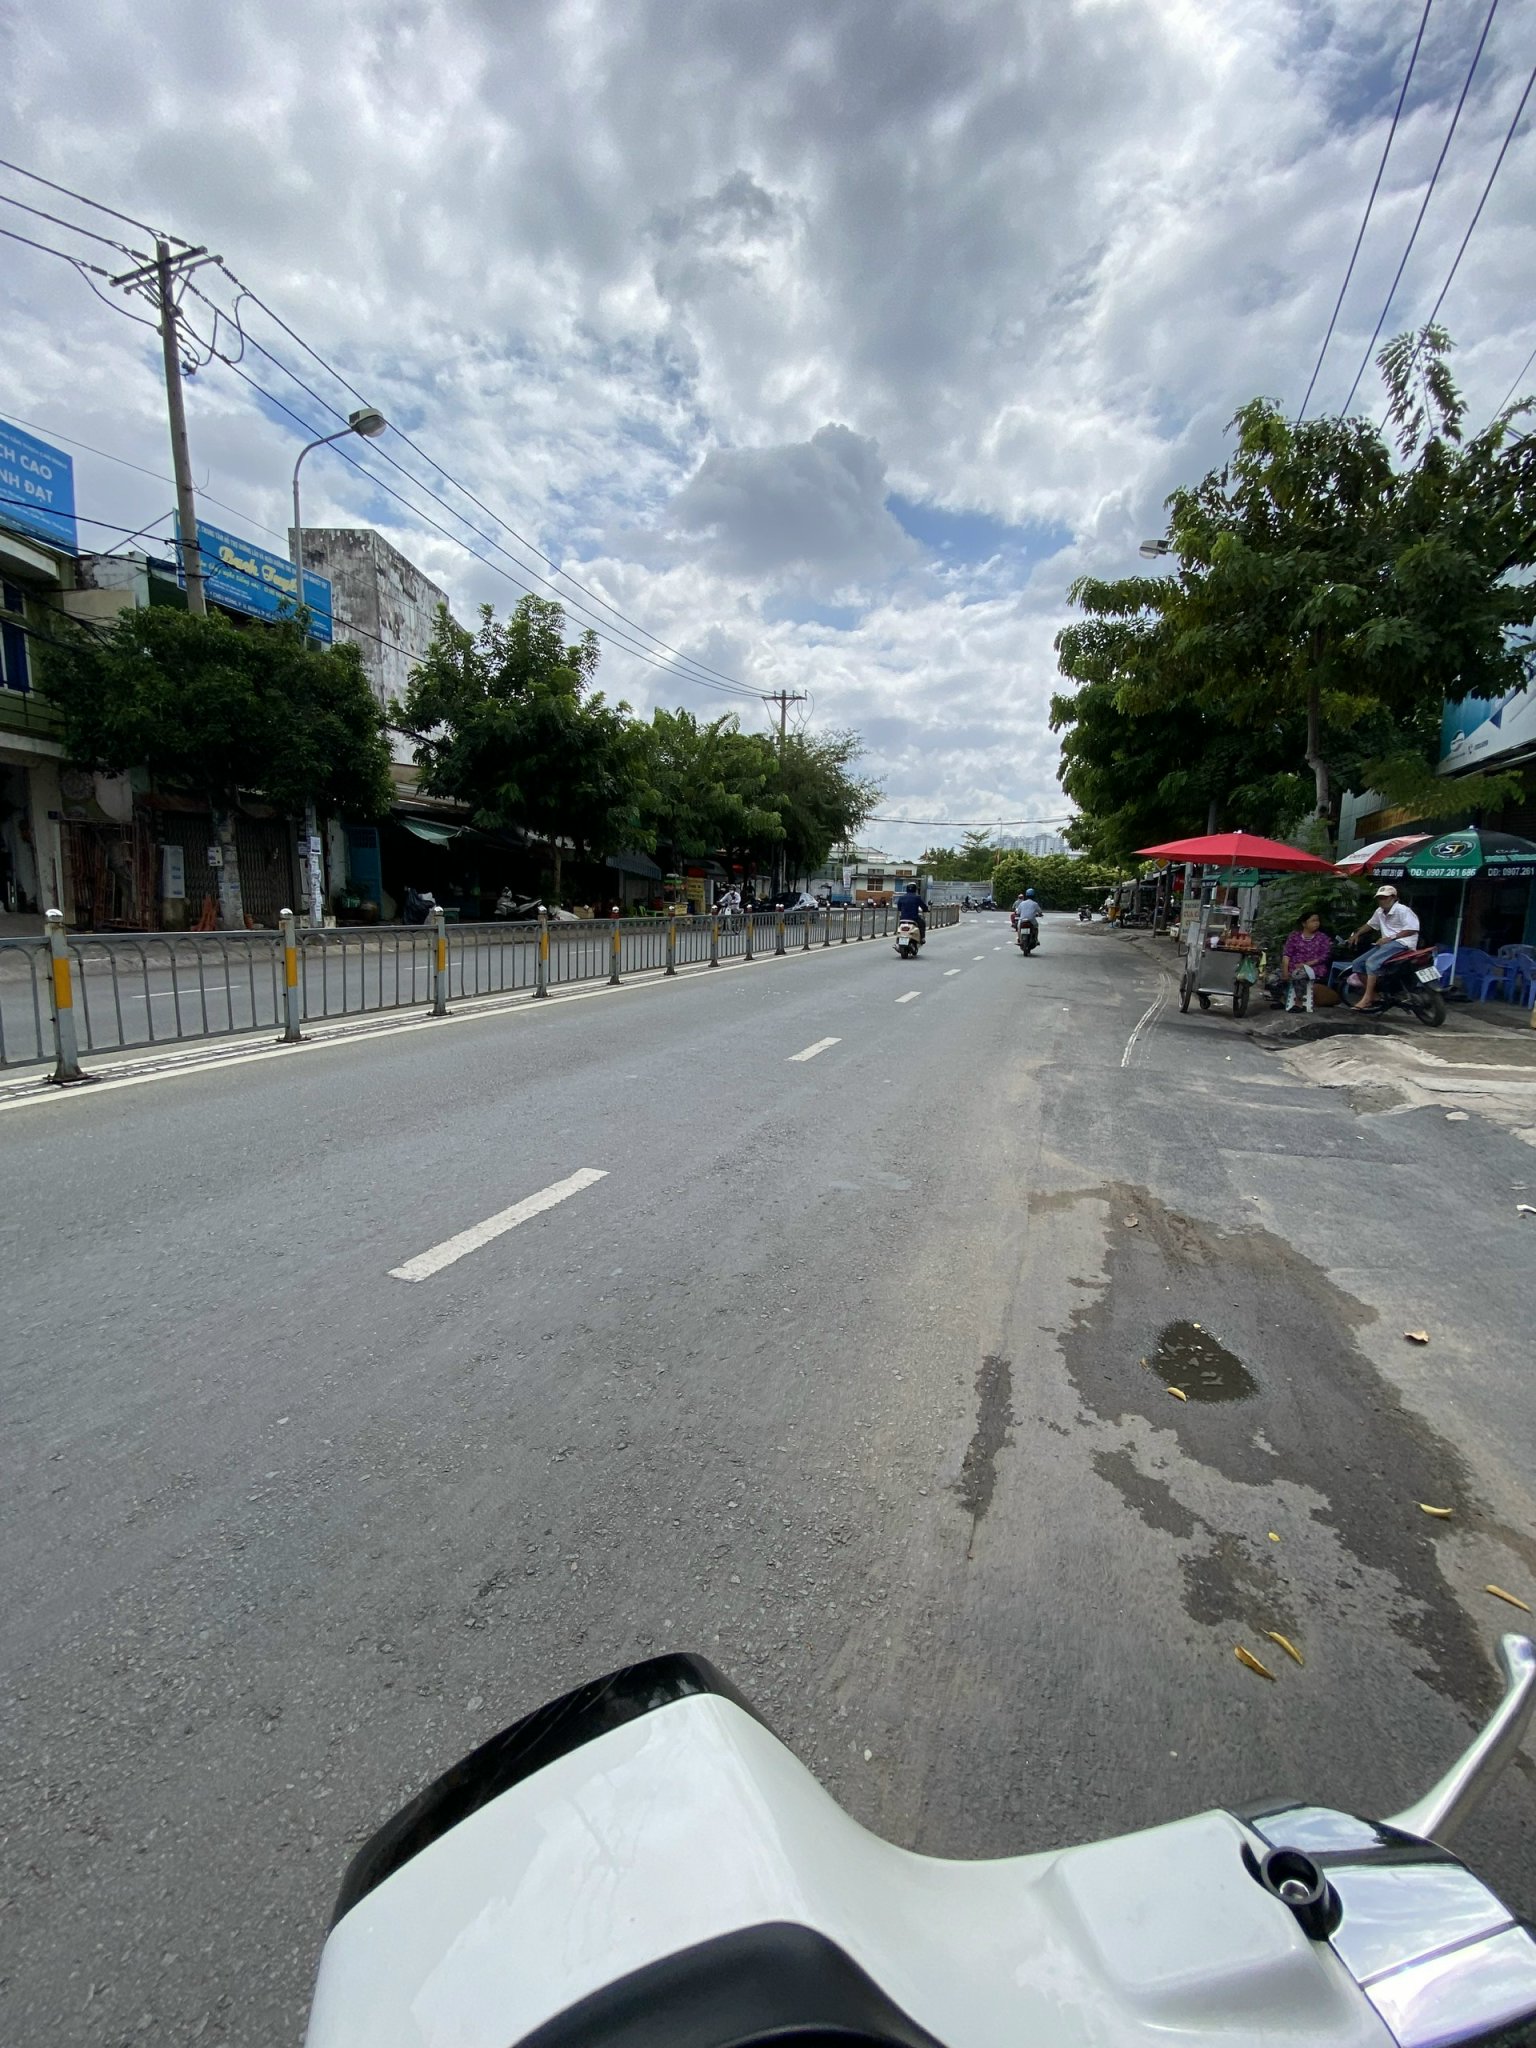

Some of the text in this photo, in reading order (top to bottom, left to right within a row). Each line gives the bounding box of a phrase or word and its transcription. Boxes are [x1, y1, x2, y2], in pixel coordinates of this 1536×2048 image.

[20, 455, 53, 480] CAO
[24, 480, 53, 503] ĐẠT
[1441, 844, 1463, 855] ST
